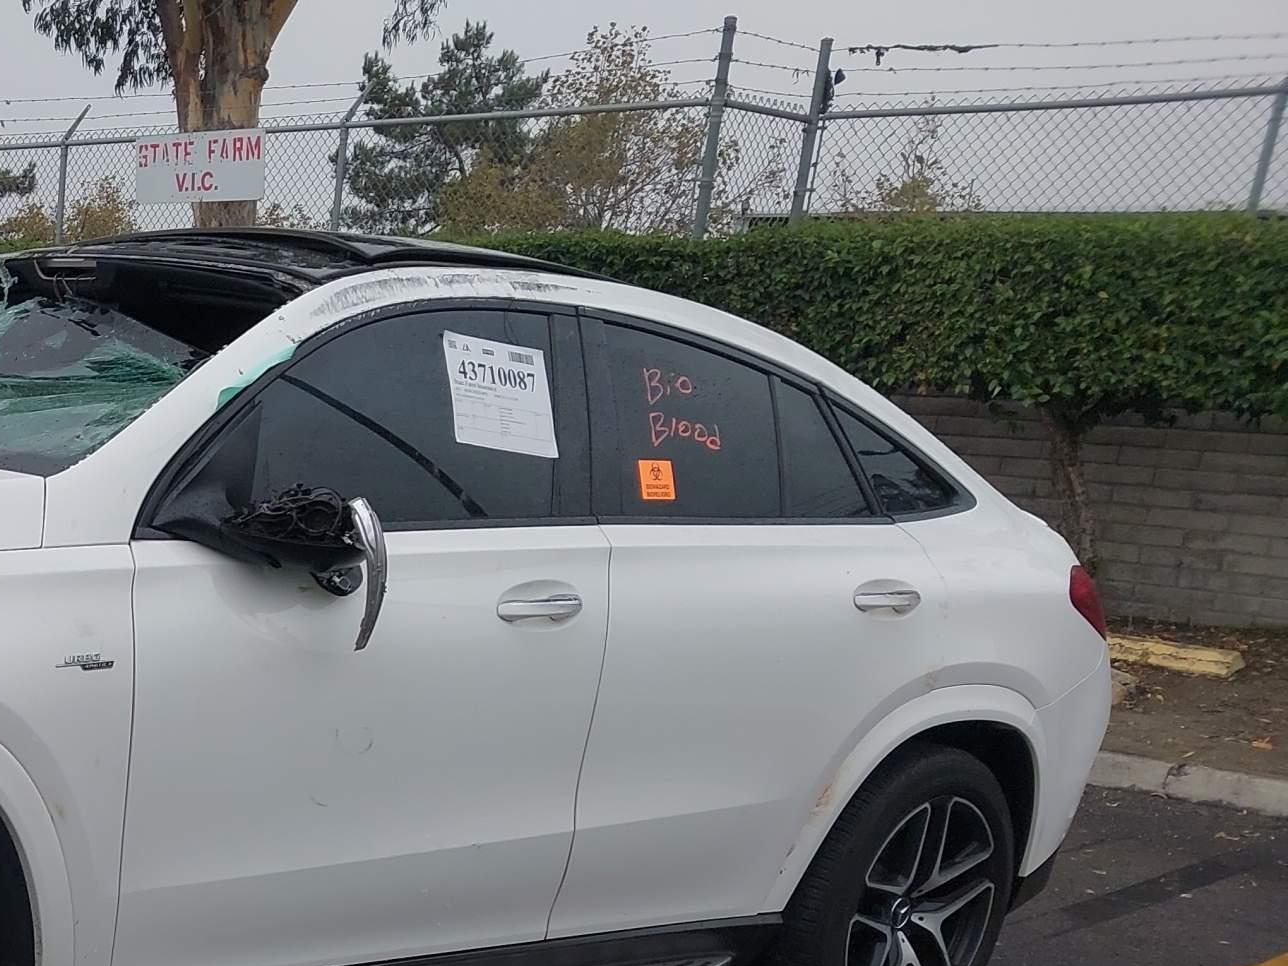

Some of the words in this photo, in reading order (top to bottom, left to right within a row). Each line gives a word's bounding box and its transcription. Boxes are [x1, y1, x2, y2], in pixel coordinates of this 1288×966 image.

[138, 141, 194, 168] STATE
[208, 136, 262, 164] FARM
[175, 171, 219, 193] V.I.C.
[457, 359, 536, 393] 43710087
